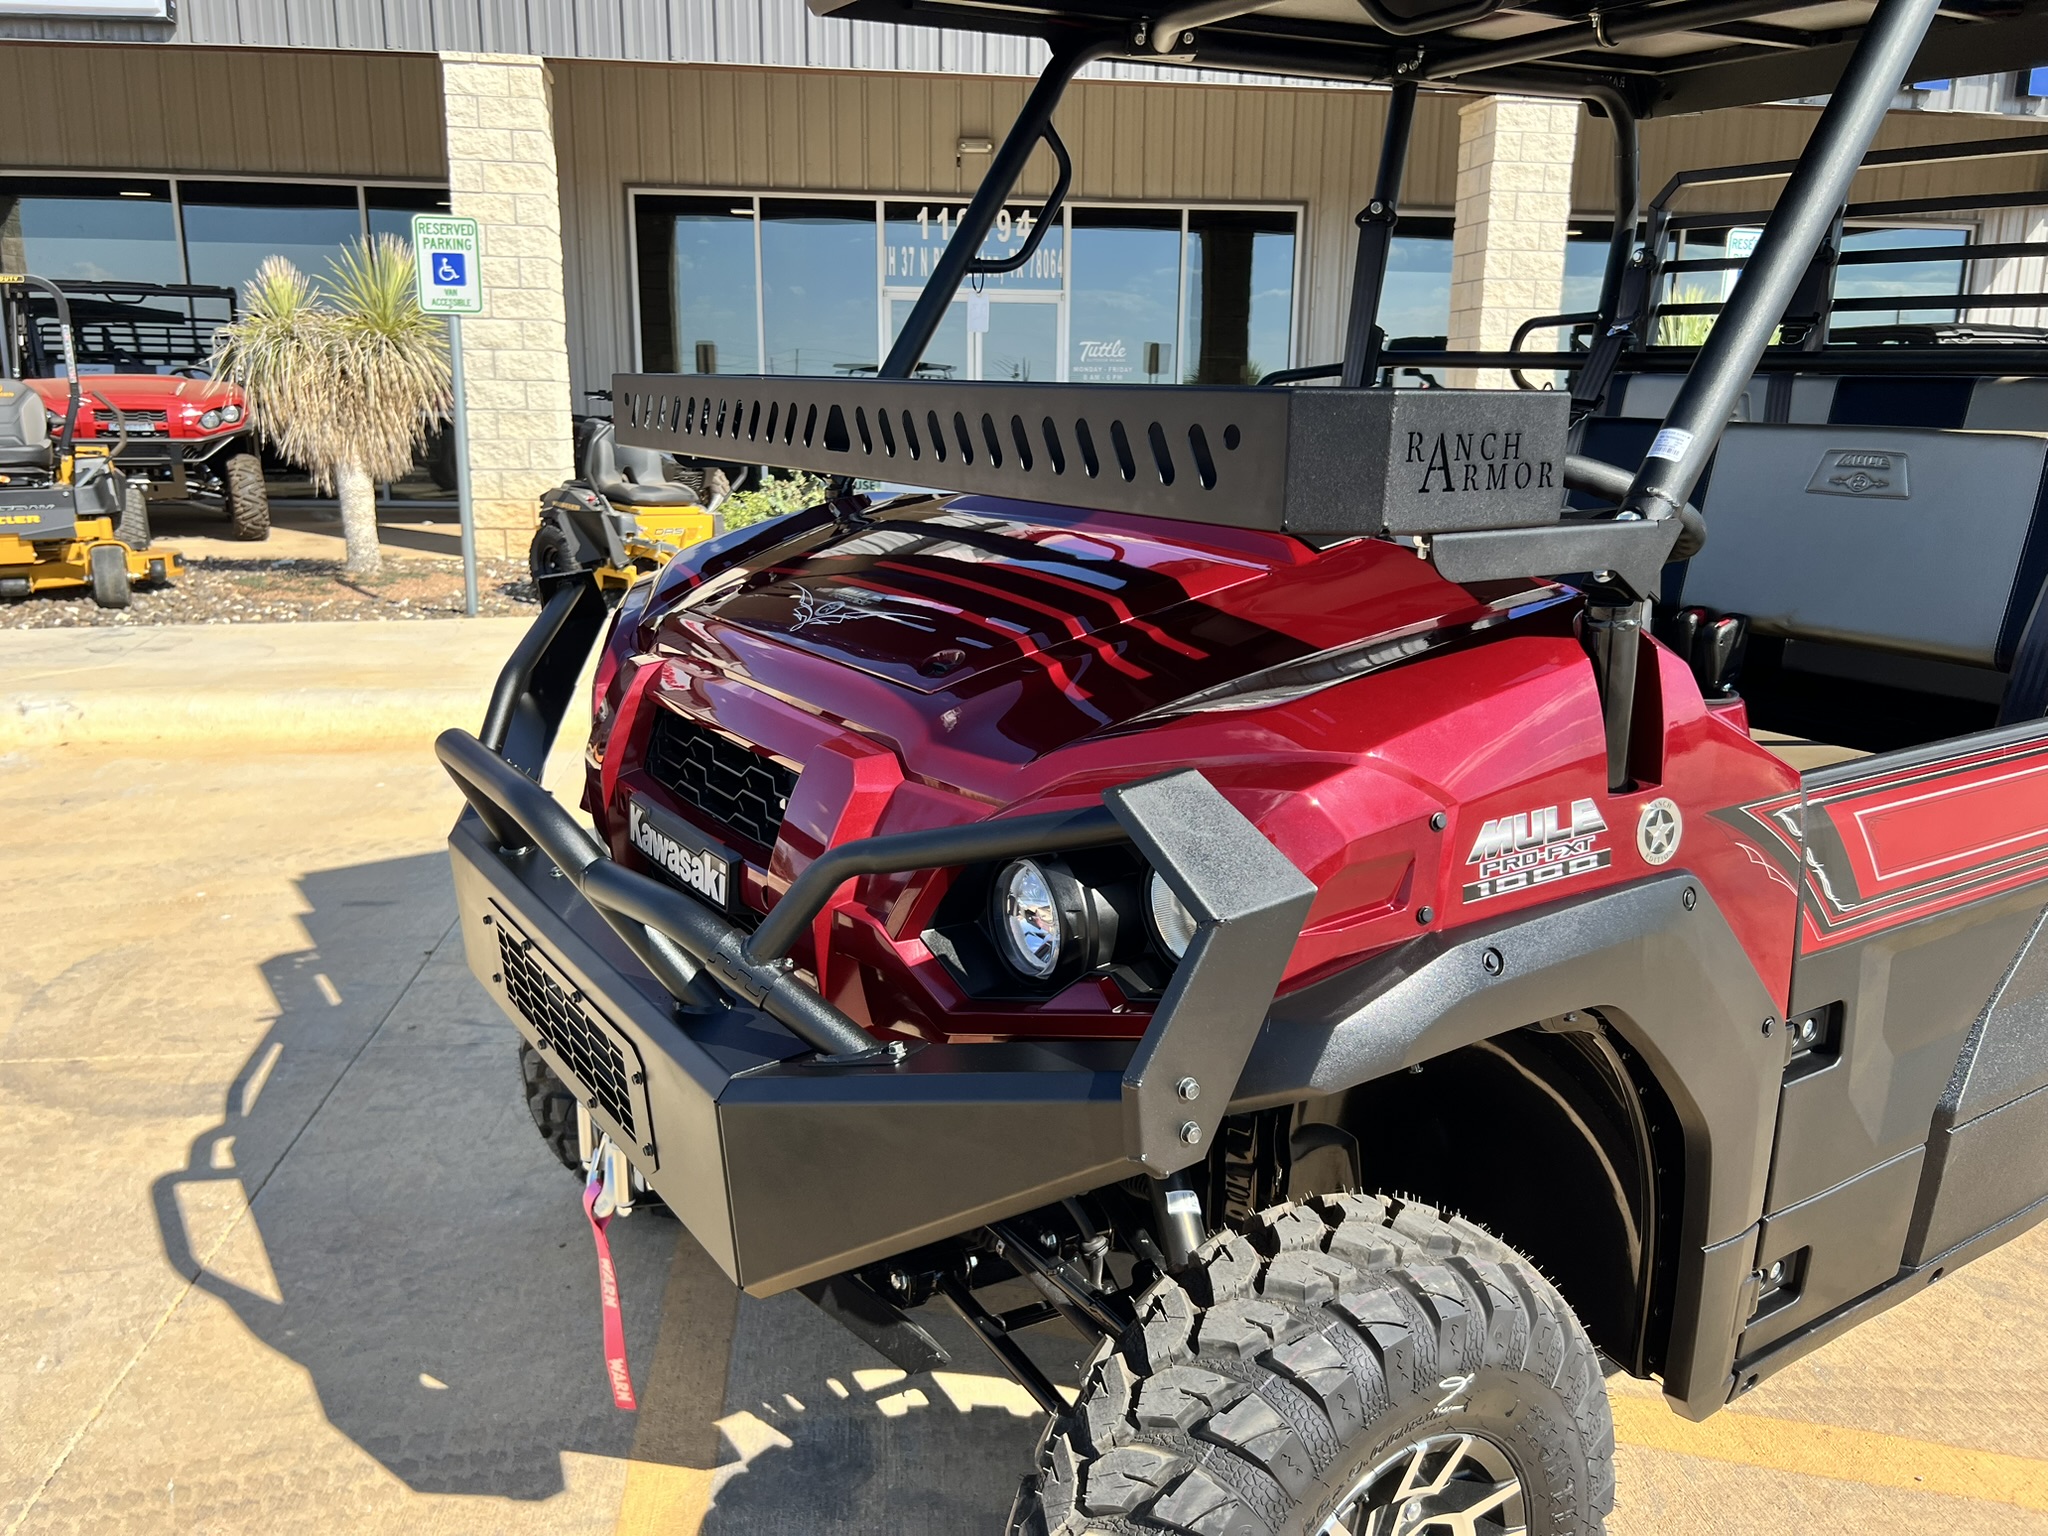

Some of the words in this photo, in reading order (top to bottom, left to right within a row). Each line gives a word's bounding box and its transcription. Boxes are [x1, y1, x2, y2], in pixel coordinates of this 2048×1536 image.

[418, 222, 475, 236] RESERVED
[422, 237, 472, 251] PARKING
[917, 206, 1034, 242] 1194
[901, 246, 915, 277] 37
[920, 246, 928, 277] N
[431, 298, 472, 307] ACCESSIBLE
[444, 288, 458, 296] VAN
[1079, 339, 1127, 362] Tuttle
[1405, 431, 1522, 493] RANCH
[1418, 432, 1554, 494] ARMOR
[1465, 797, 1608, 865] MULE
[629, 802, 728, 906] Kawasaki
[1477, 853, 1600, 897] 1000
[1479, 835, 1596, 879] PRO-FXT
[599, 1257, 618, 1309] WARN
[607, 1357, 633, 1403] WARN
